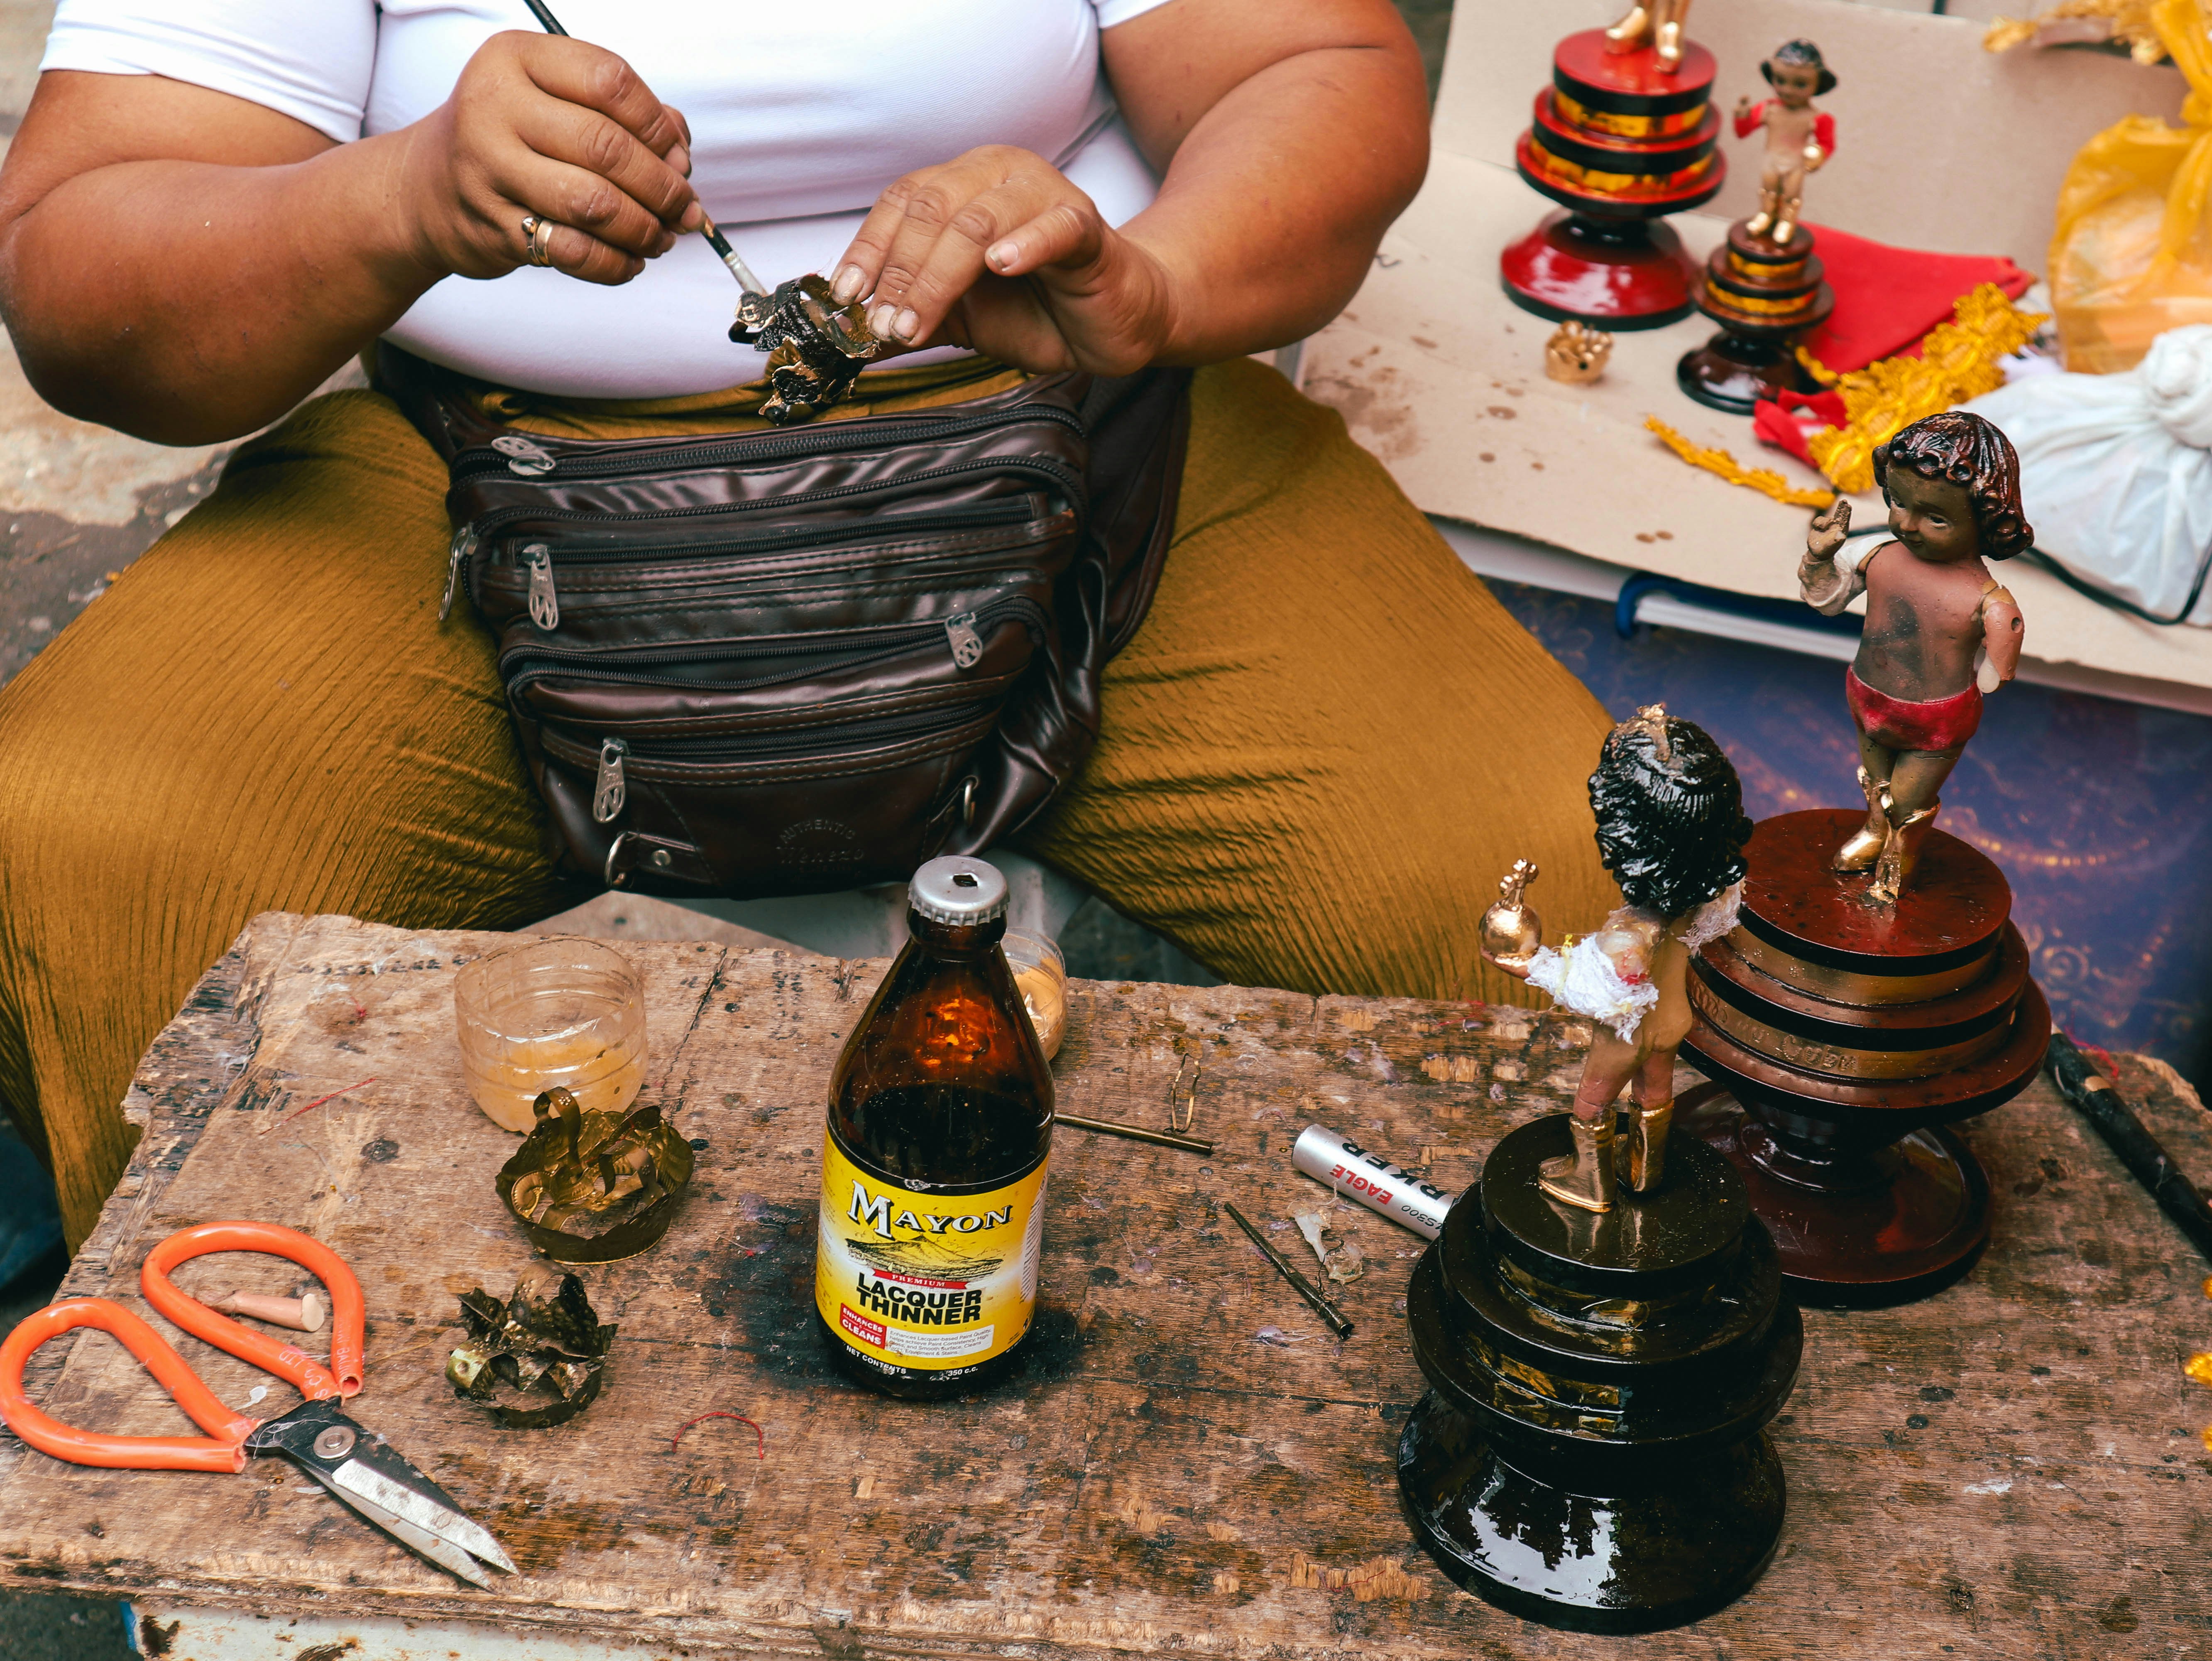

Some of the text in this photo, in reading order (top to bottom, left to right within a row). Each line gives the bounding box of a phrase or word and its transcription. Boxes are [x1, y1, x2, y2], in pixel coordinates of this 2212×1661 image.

[779, 818, 855, 844] AUTHENTIC
[1329, 1164, 1394, 1205] EAGLE
[1342, 1142, 1448, 1200] RKER
[847, 1179, 1013, 1241] MAYON
[858, 1272, 982, 1309] LACQUER
[892, 1274, 947, 1287] PREMIUM
[842, 1307, 883, 1333] ENHANCES
[856, 1286, 981, 1325] THINNER
[842, 1318, 882, 1345] CLEANS
[890, 1330, 916, 1340] Enhances
[846, 1345, 907, 1374] NET CONTENTS
